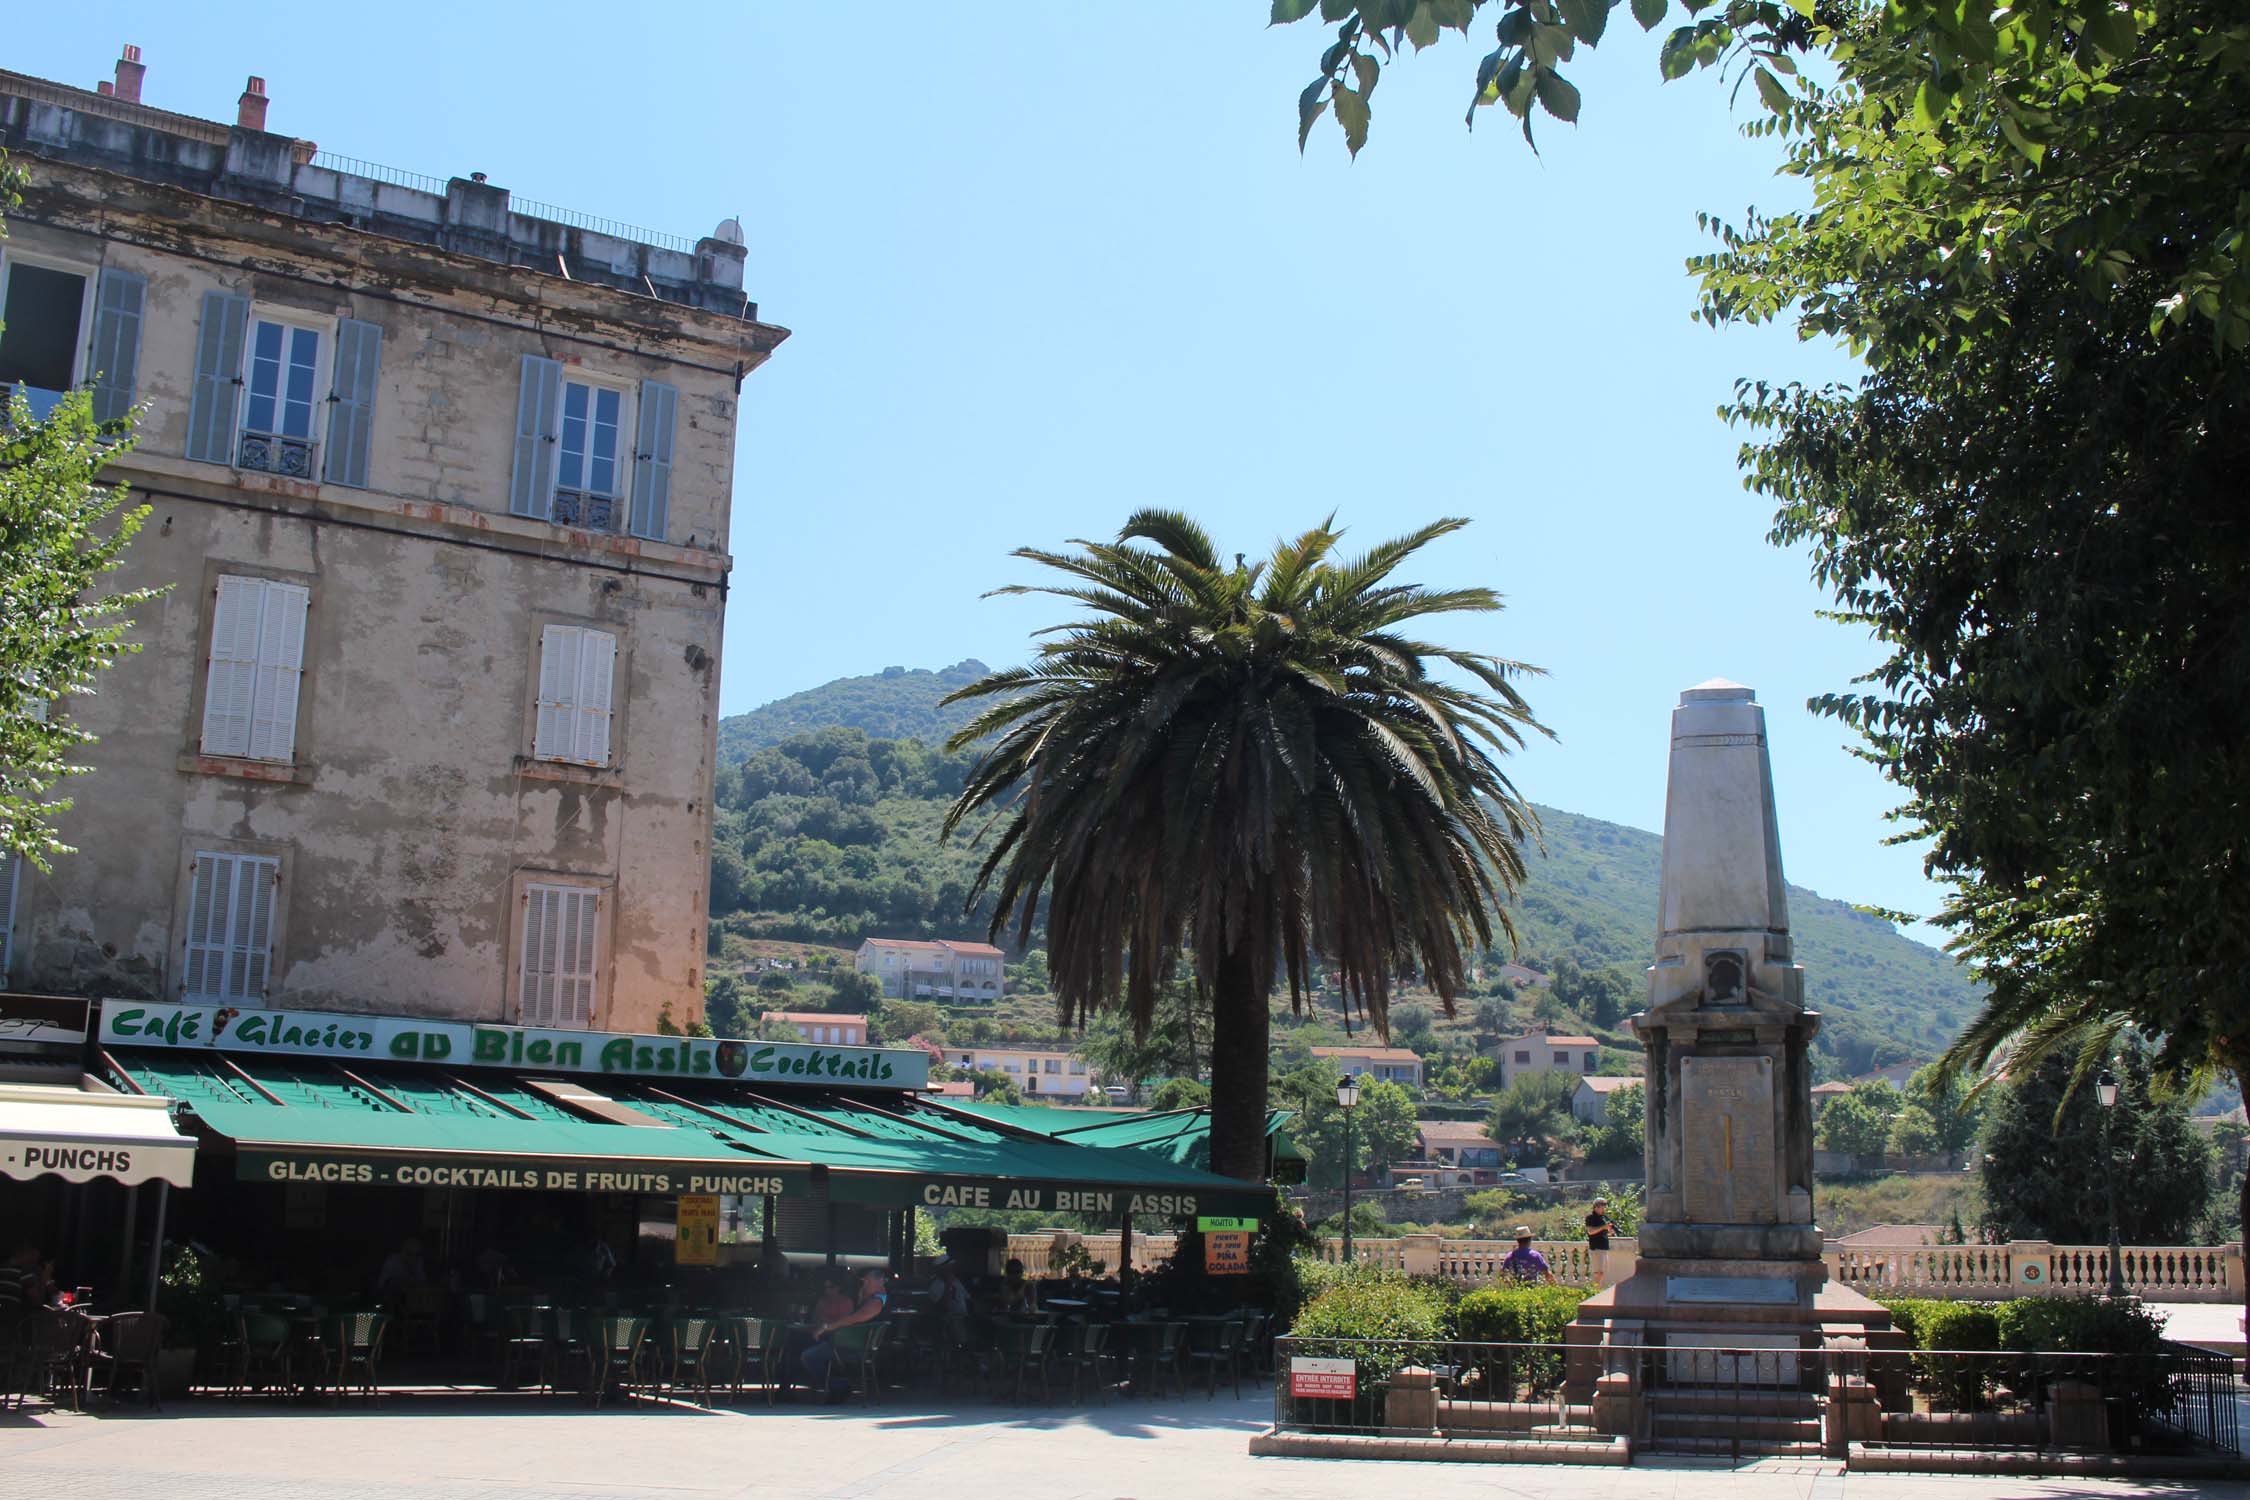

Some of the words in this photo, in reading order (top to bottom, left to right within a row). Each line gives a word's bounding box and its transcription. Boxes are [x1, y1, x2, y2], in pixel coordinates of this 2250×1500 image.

[111, 1008, 202, 1046] Café
[235, 1014, 373, 1051] Glacier
[474, 1028, 582, 1067] Bien
[599, 1038, 712, 1075] Assis
[750, 1045, 893, 1081] Cocktails
[24, 1147, 131, 1172] PUNCHS
[268, 1160, 374, 1183] GLACES
[396, 1165, 539, 1189] COCKTAILS
[546, 1171, 578, 1190] DE
[584, 1172, 671, 1192] FRUITS
[689, 1175, 784, 1195] PUNCHS
[923, 1183, 991, 1208] CAFE
[1006, 1188, 1041, 1210] AU
[1055, 1190, 1113, 1212] BIEN
[1127, 1194, 1198, 1215] ASSIS
